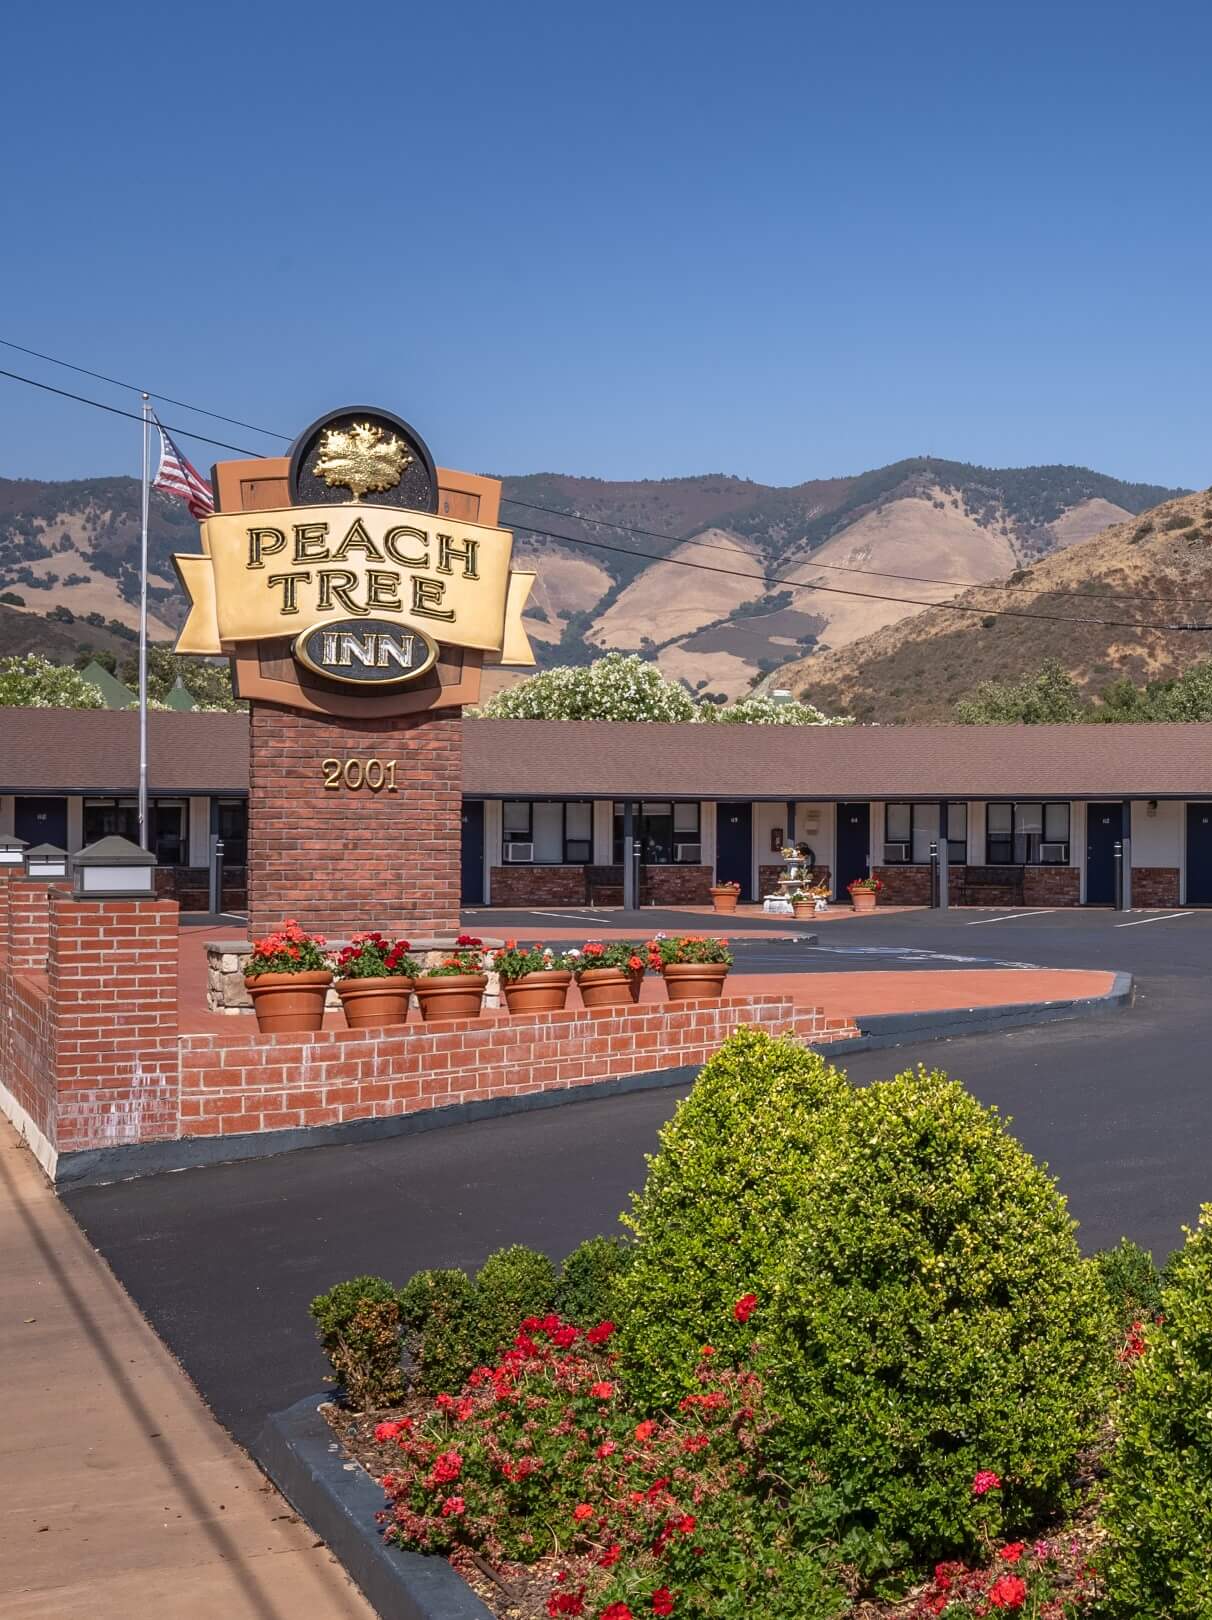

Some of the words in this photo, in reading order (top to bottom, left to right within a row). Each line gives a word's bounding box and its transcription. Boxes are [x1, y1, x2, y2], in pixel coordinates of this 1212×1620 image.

[246, 518, 480, 580] PEACH
[268, 570, 456, 622] TREE
[321, 631, 416, 668] INN
[321, 758, 399, 793] 2001
